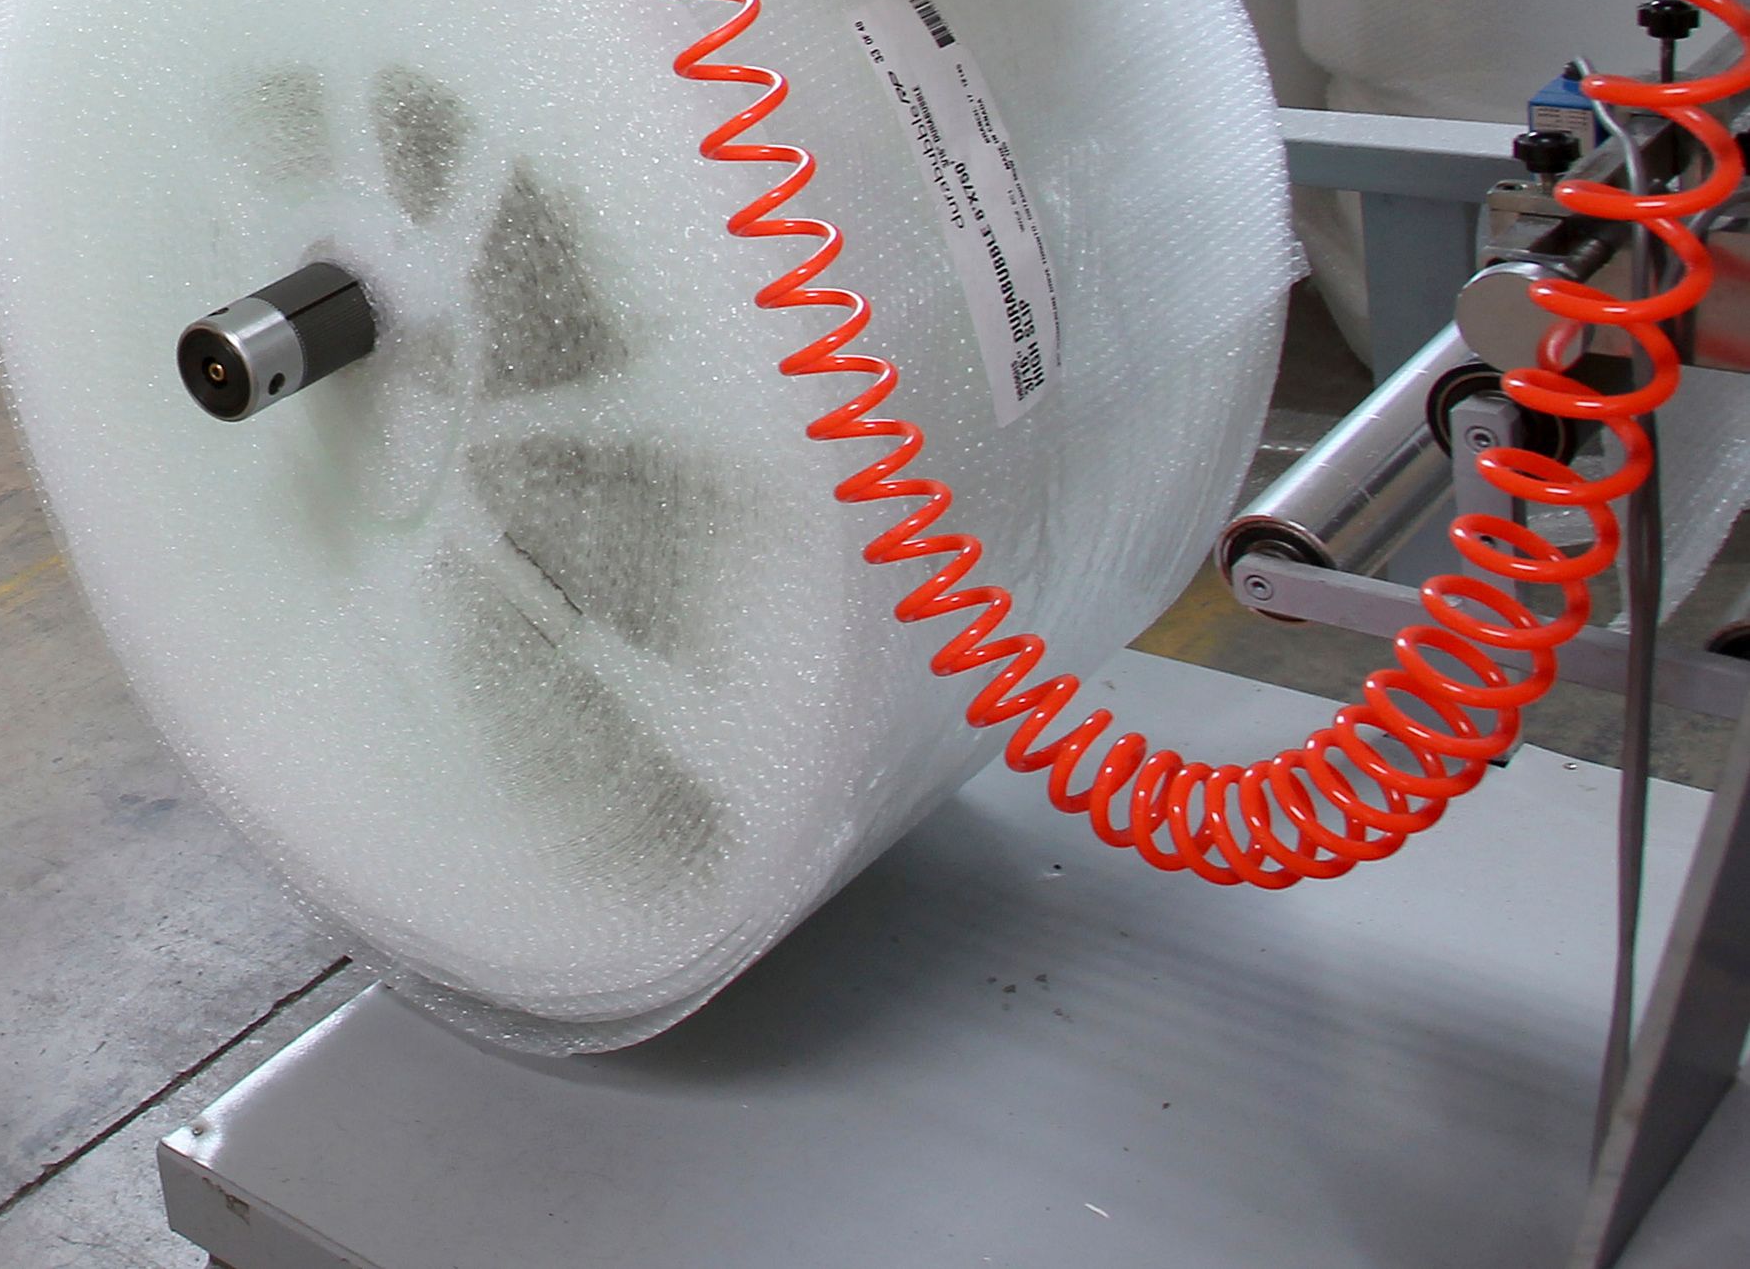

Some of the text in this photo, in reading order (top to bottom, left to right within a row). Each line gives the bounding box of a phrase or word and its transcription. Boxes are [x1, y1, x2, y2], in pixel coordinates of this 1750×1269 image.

[862, 35, 874, 46] OF
[870, 49, 885, 64] 33
[910, 105, 964, 229] durabubble
[980, 223, 1025, 343] DURABUBBLE
[1018, 299, 1045, 387] HIGH SLIP
